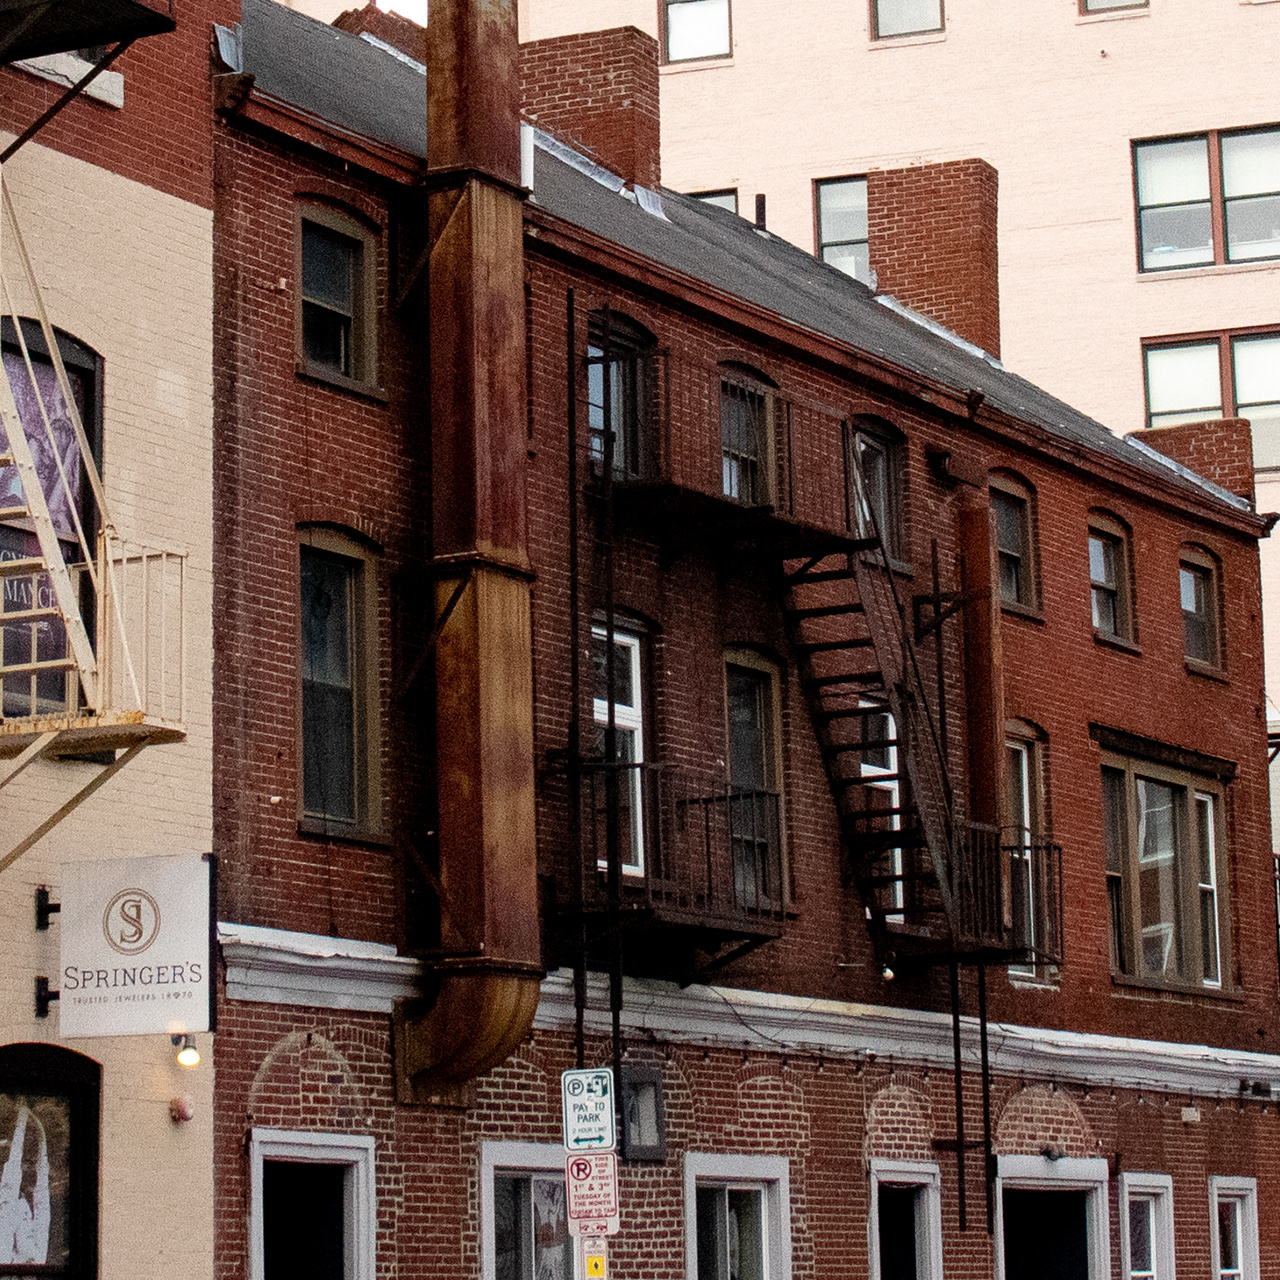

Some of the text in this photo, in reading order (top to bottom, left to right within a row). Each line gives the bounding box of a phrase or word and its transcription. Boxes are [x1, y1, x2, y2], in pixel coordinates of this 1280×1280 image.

[63, 961, 203, 990] SPRINGER'S
[73, 995, 109, 1005] TRUSTED
[114, 994, 157, 1003] JEWELERS
[573, 1102, 605, 1113] PAY TO
[577, 1113, 601, 1123] PARK
[588, 1183, 595, 1191] &
